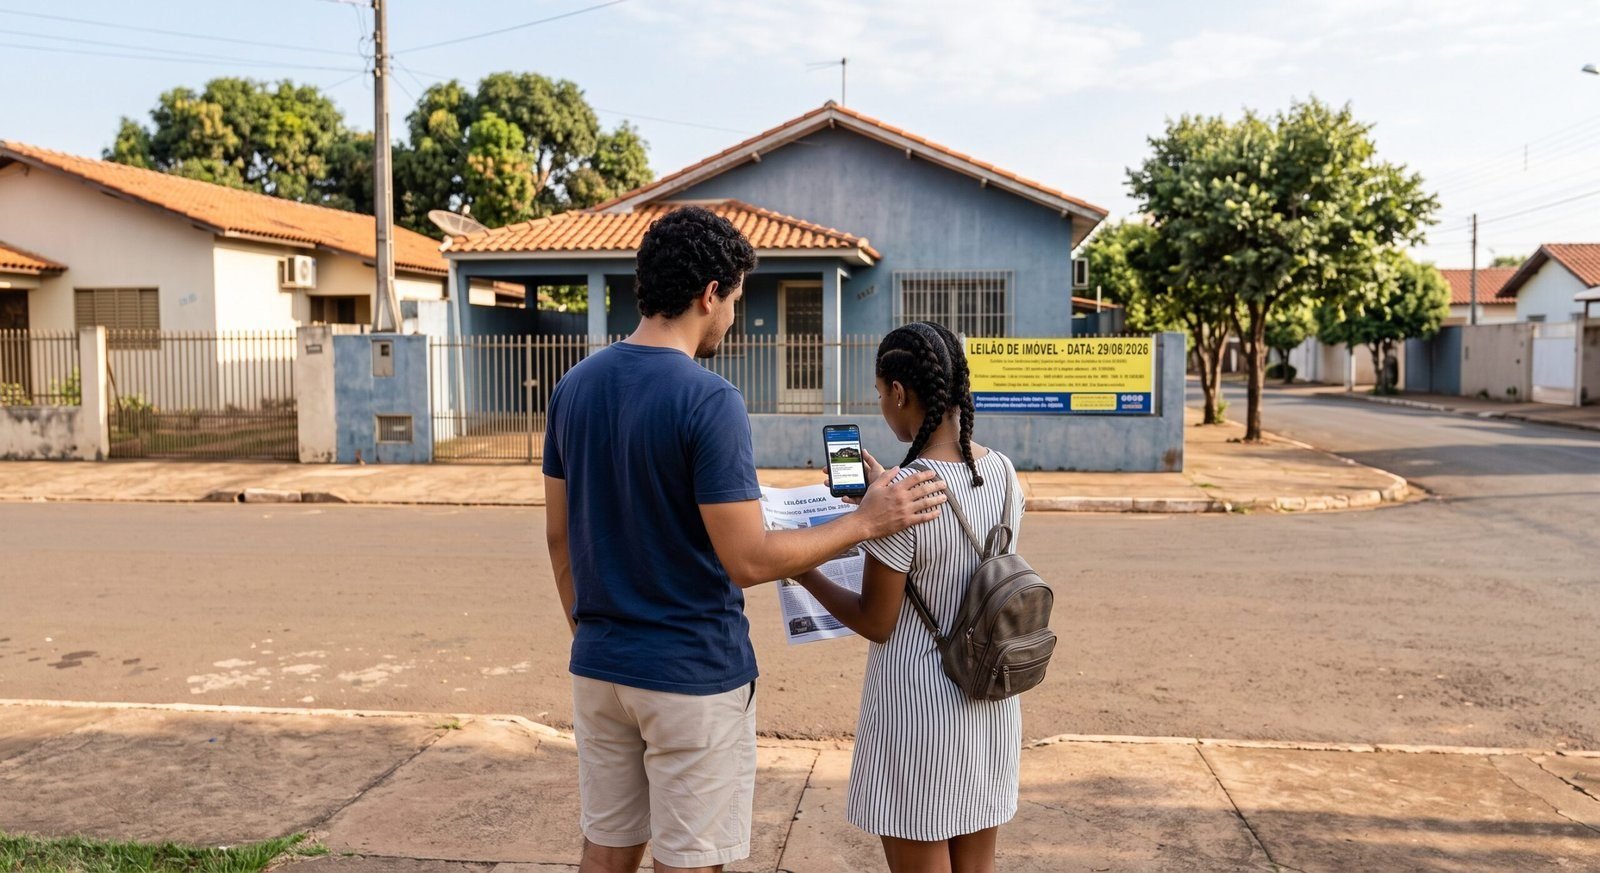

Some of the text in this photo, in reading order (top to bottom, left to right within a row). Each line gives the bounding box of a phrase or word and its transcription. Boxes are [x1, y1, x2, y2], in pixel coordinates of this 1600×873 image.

[970, 341, 1004, 355] LEILÃO
[1007, 343, 1019, 355] DE
[1022, 341, 1058, 355] IMÓVEL
[1067, 343, 1095, 355] DATA:
[808, 496, 827, 504] CAIXA
